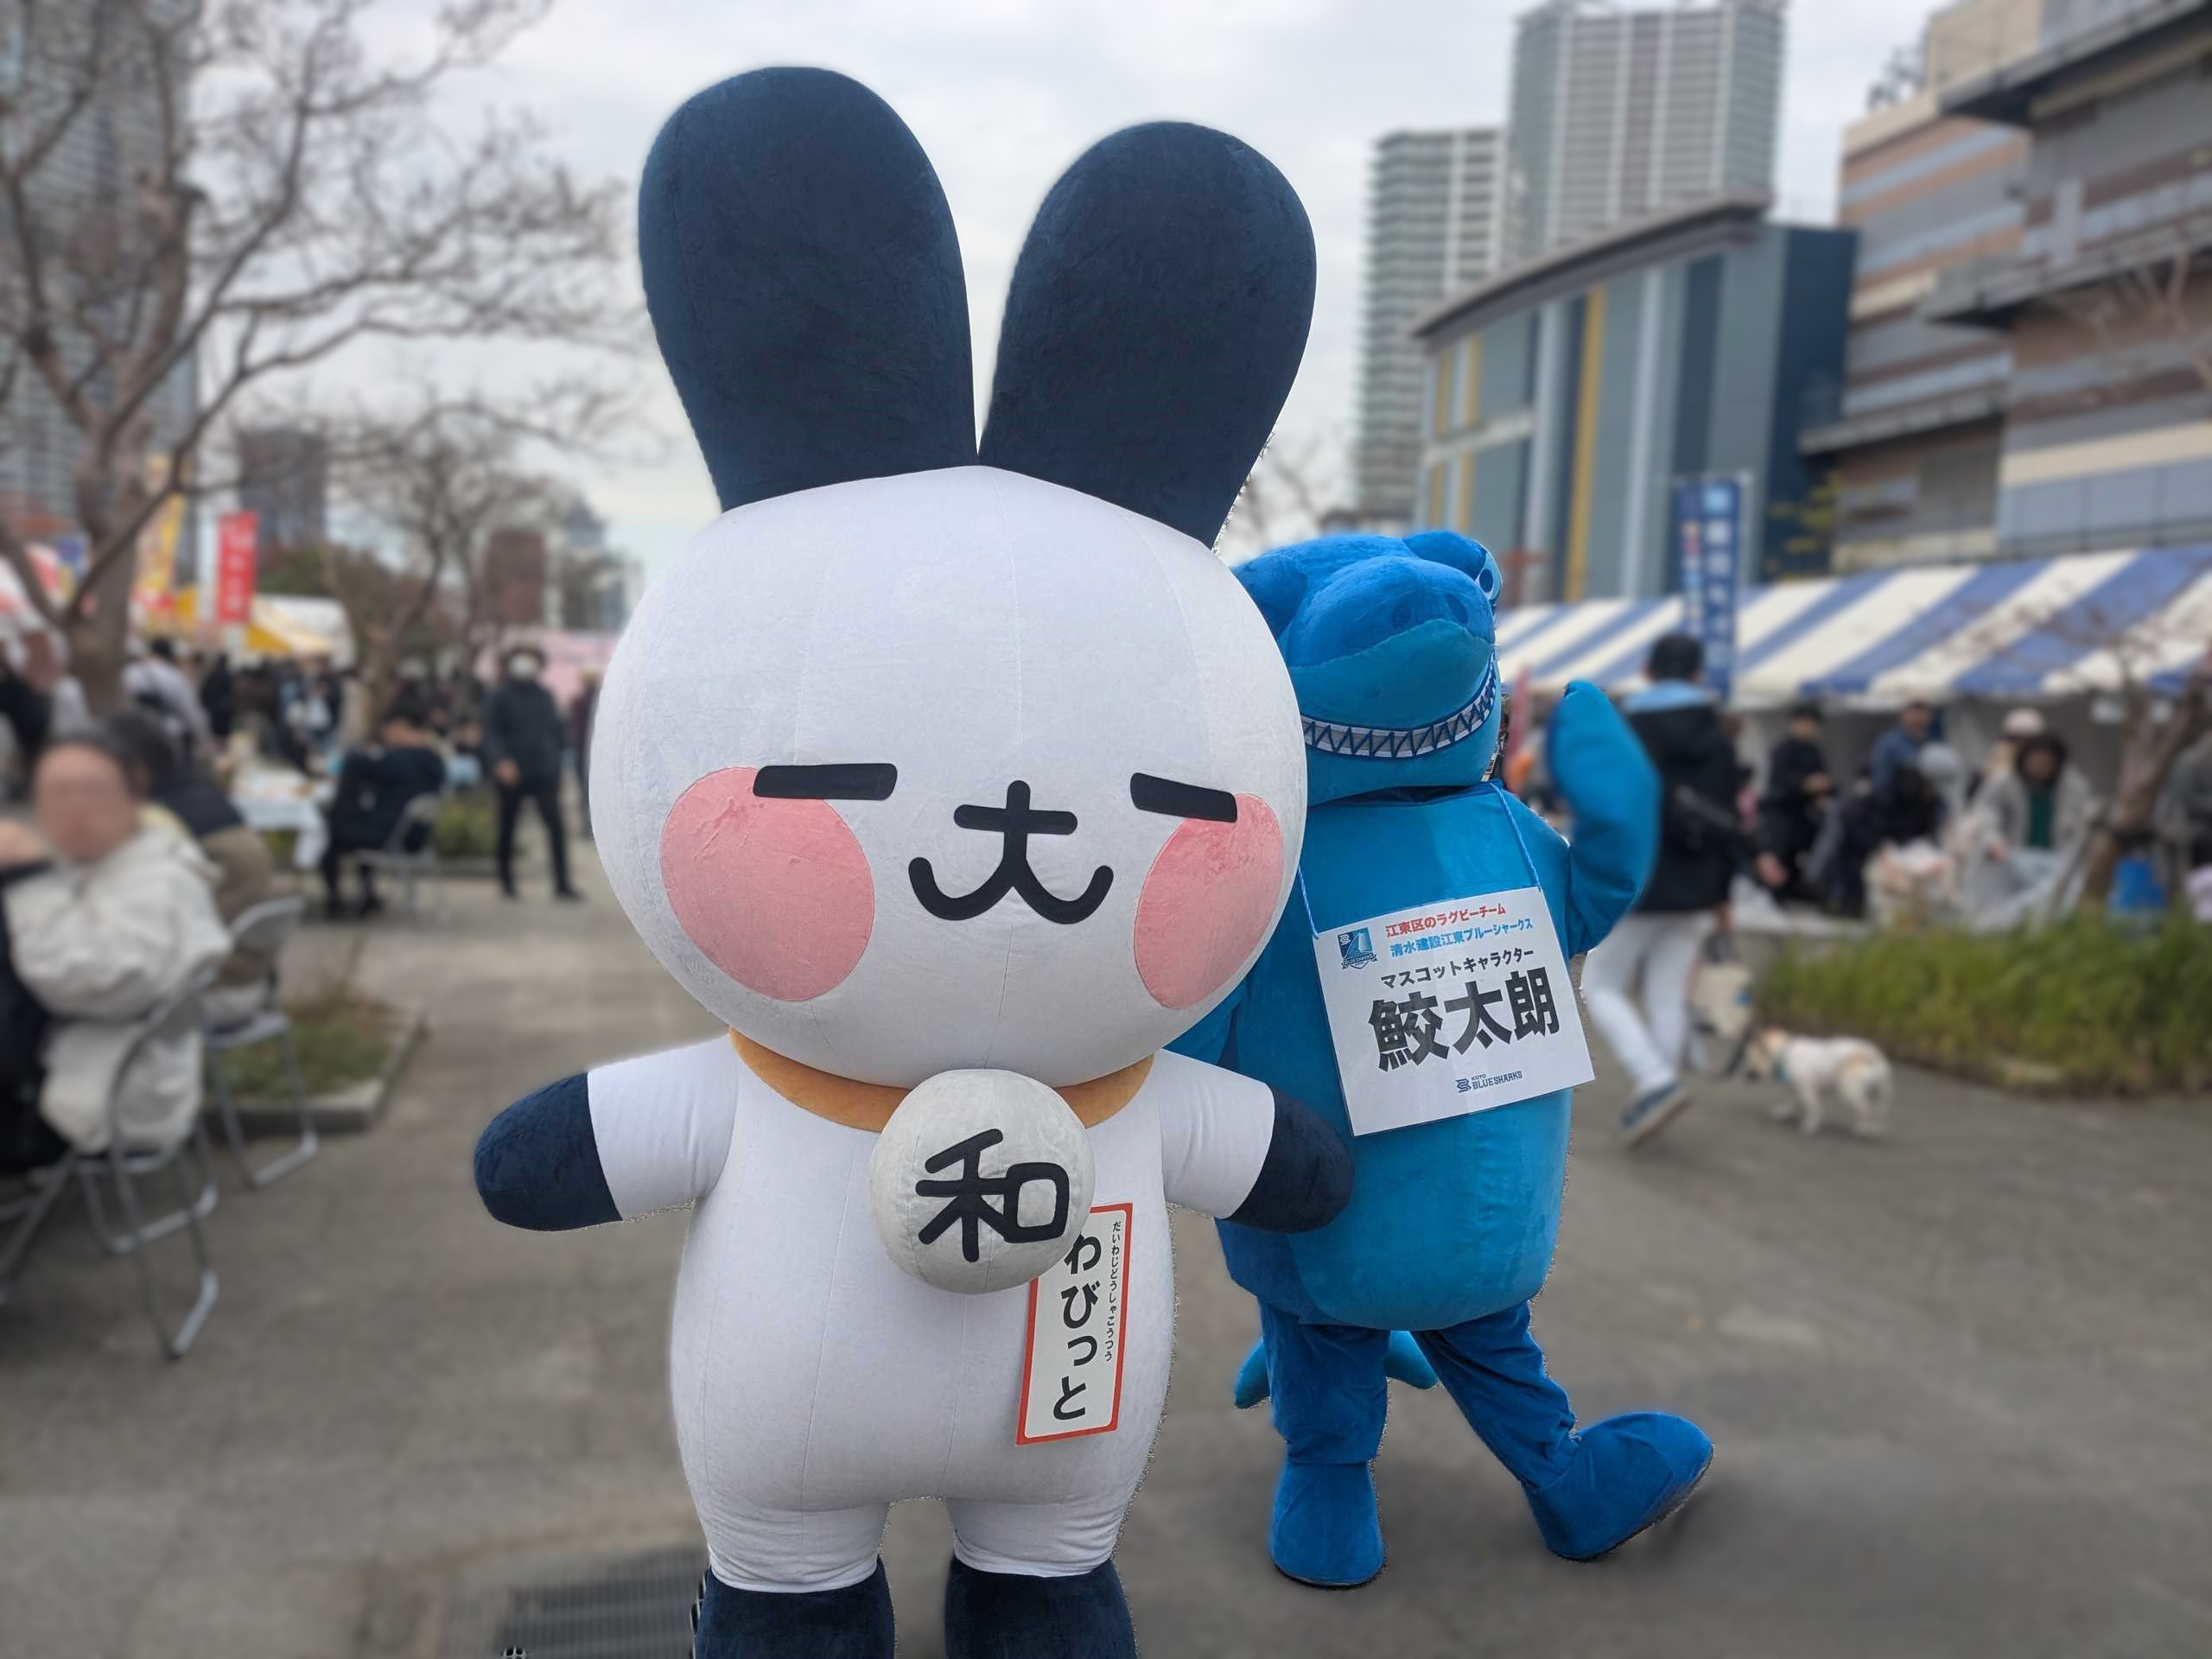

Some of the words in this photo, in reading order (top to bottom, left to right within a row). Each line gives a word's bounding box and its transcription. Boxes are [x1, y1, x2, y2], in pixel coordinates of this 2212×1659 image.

[1380, 947, 1535, 989] マスコットキャラクター
[1384, 903, 1506, 938] 江東区のラグビーチーム
[1389, 918, 1534, 957] 清水建設江東ブルーシャークス
[1368, 966, 1560, 1072] 鮫太朗
[914, 1128, 1071, 1263] 和
[1052, 1233, 1103, 1421] わびっと
[1104, 1221, 1122, 1362] だいわじどうしゃこうつう
